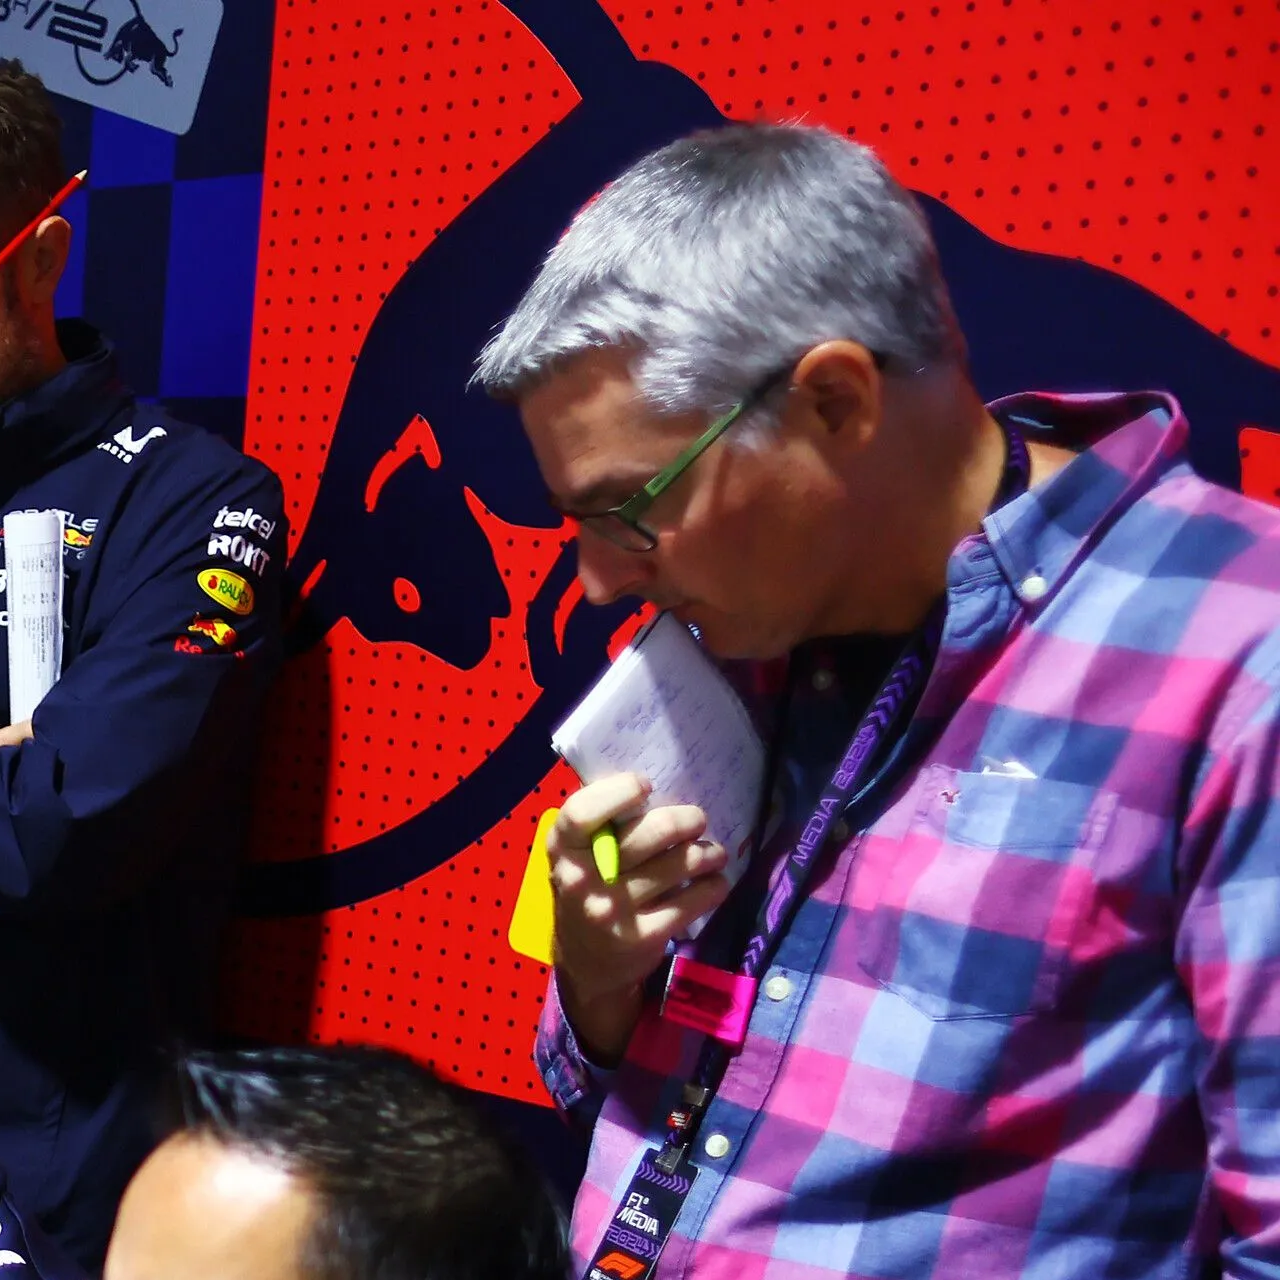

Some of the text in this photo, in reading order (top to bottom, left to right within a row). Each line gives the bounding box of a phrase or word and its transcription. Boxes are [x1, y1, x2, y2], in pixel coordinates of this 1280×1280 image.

[213, 506, 276, 540] telcel
[208, 533, 270, 576] ROKT
[792, 798, 840, 867] MEDIA
[616, 1207, 659, 1236] MEDIA
[606, 1225, 650, 1254] 2024
